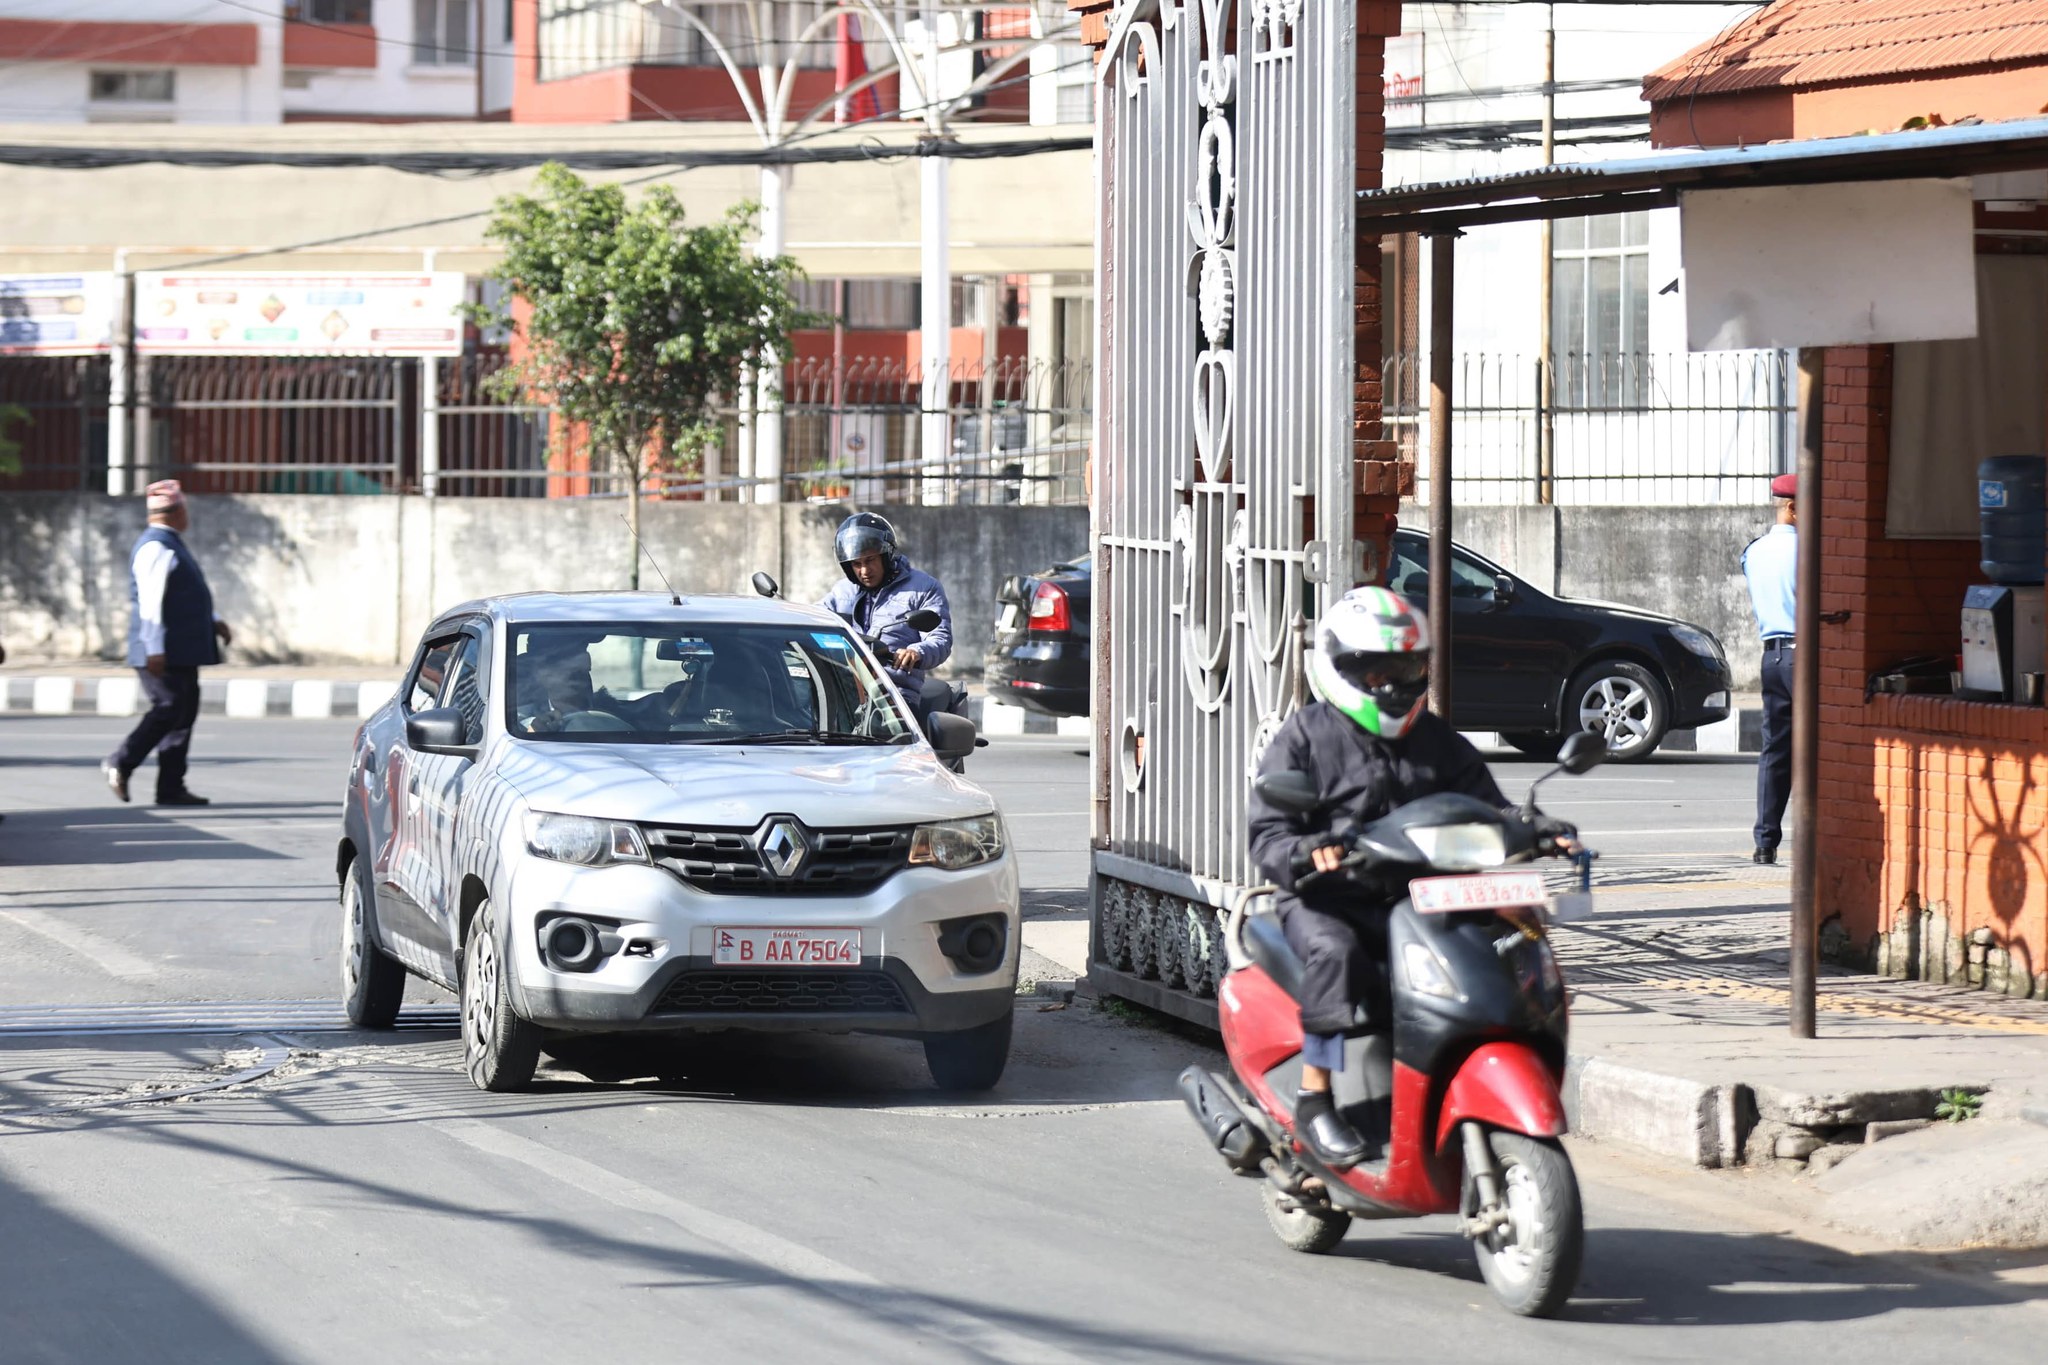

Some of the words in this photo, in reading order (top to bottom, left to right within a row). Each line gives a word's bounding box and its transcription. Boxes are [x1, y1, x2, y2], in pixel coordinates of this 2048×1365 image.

[772, 930, 806, 939] BAGMATI
[740, 940, 754, 961] B
[765, 939, 850, 961] AA7504
